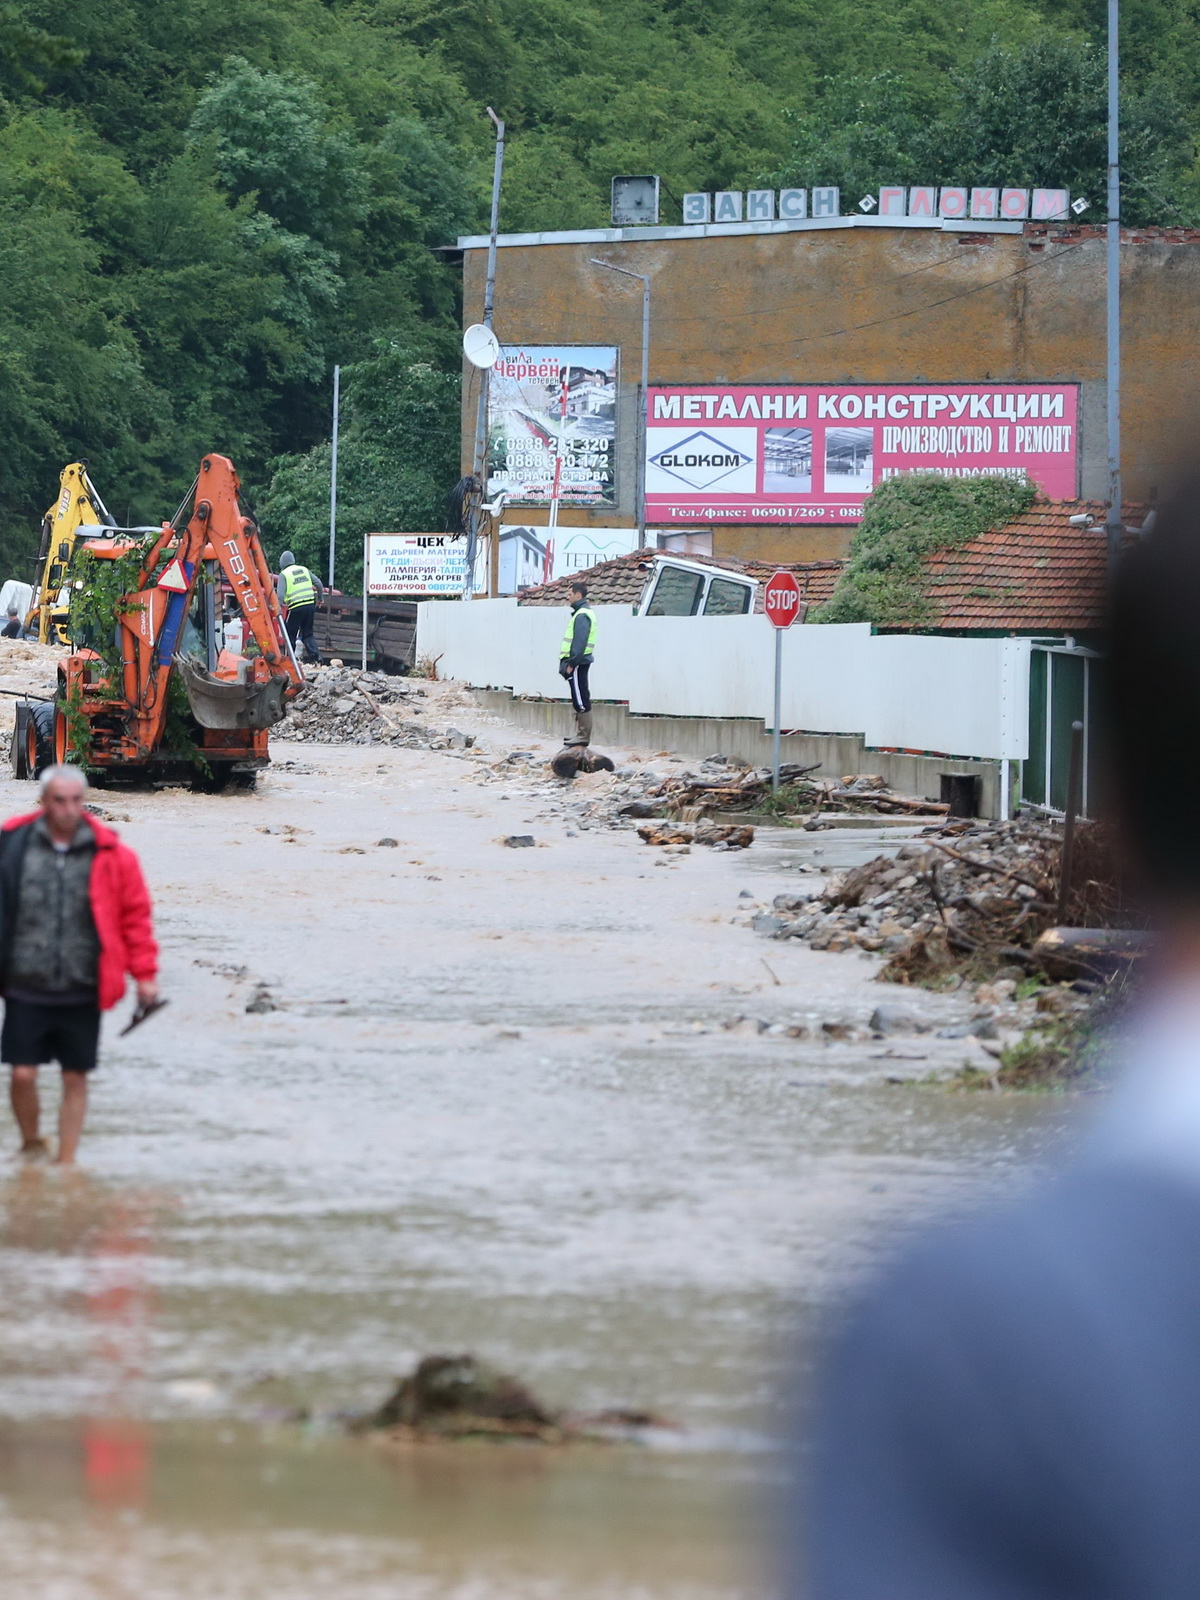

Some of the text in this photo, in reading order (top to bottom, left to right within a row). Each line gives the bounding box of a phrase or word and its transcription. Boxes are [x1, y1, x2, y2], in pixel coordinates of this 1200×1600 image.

[685, 189, 1066, 219] ЗАКСН ГЛОКОМ
[494, 360, 560, 381] Червен
[653, 393, 1065, 423] МЕТАЛНИ КОНСТРУКЦИИ
[506, 437, 543, 451] 0888
[580, 437, 609, 451] 320
[882, 425, 1072, 458] ПРОИЗВОДСТВО И РЕМОНТ
[506, 453, 543, 467] 0888
[582, 453, 609, 467] 172
[660, 453, 740, 467] GLOKOM
[493, 470, 609, 481] ПРЯСНА ПСТЪРВА
[523, 483, 603, 491] www.villcherven.com
[668, 507, 747, 519] Тел./факс:
[751, 507, 825, 518] 06901/269
[417, 537, 445, 548] ЦЕХ
[385, 566, 436, 574] ЛАМПЕРИЯ
[389, 574, 419, 582] ДЪРВА
[767, 588, 798, 611] STOP
